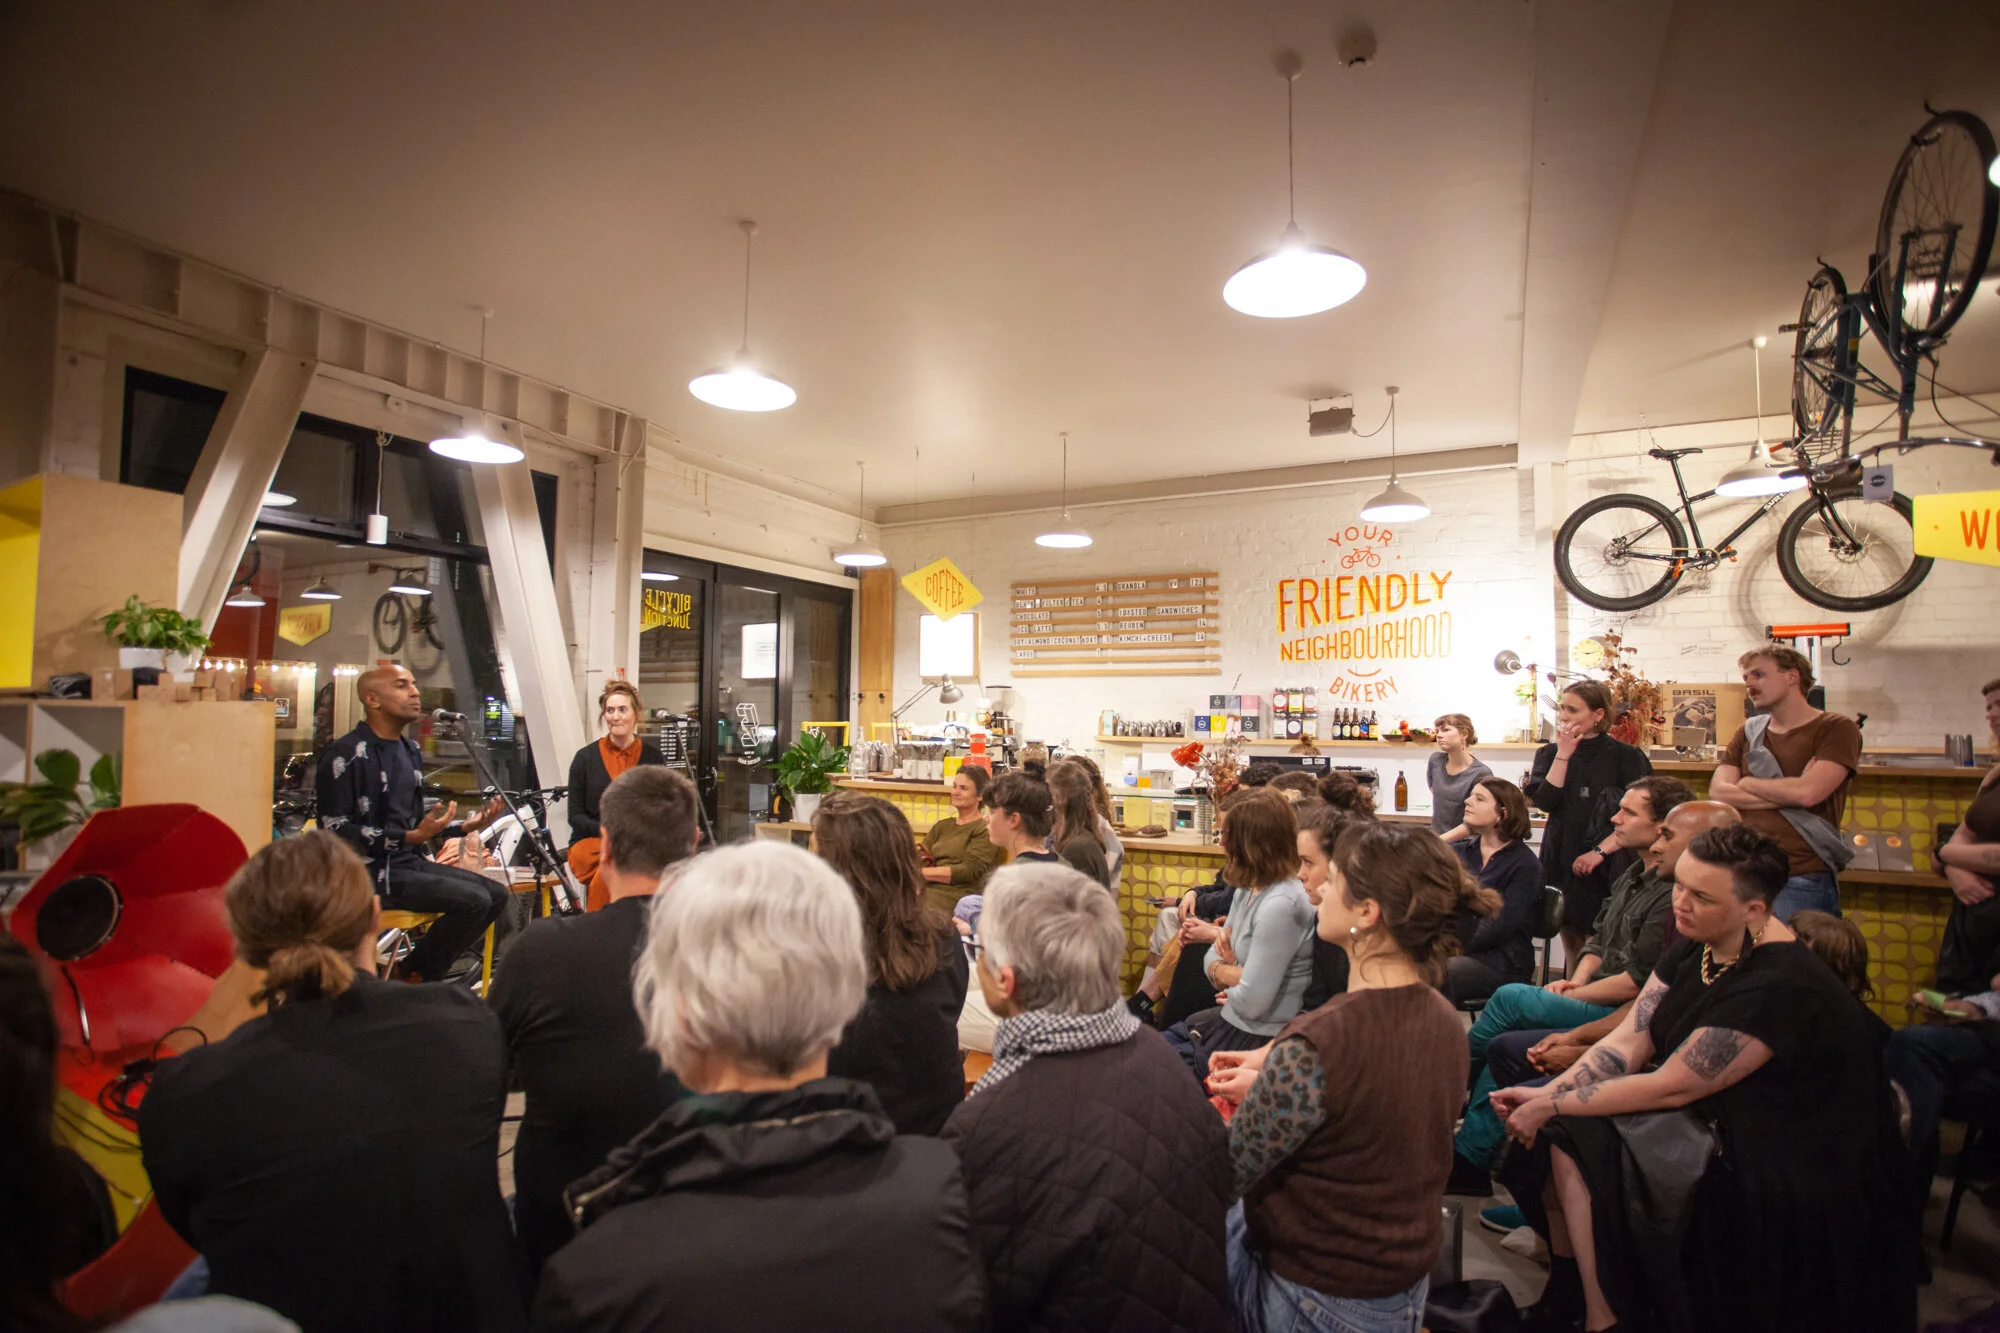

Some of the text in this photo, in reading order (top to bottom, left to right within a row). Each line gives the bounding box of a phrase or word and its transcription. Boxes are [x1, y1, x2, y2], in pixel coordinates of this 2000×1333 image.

[1328, 525, 1393, 547] YOUR
[1960, 508, 2000, 552] W
[926, 568, 964, 611] COFFEE
[1117, 581, 1145, 590] GRANOLA
[1042, 599, 1064, 607] FILTER
[1277, 570, 1453, 634] FRIENDLY
[1016, 612, 1049, 620] CHOCOLATE
[1119, 606, 1198, 616] TOASTED SANDWICHES
[1033, 625, 1052, 633] LATTE
[1280, 611, 1452, 662] NEIGHBOURHOOD
[1015, 650, 1034, 658] LARGE
[1329, 676, 1399, 703] BIKERY
